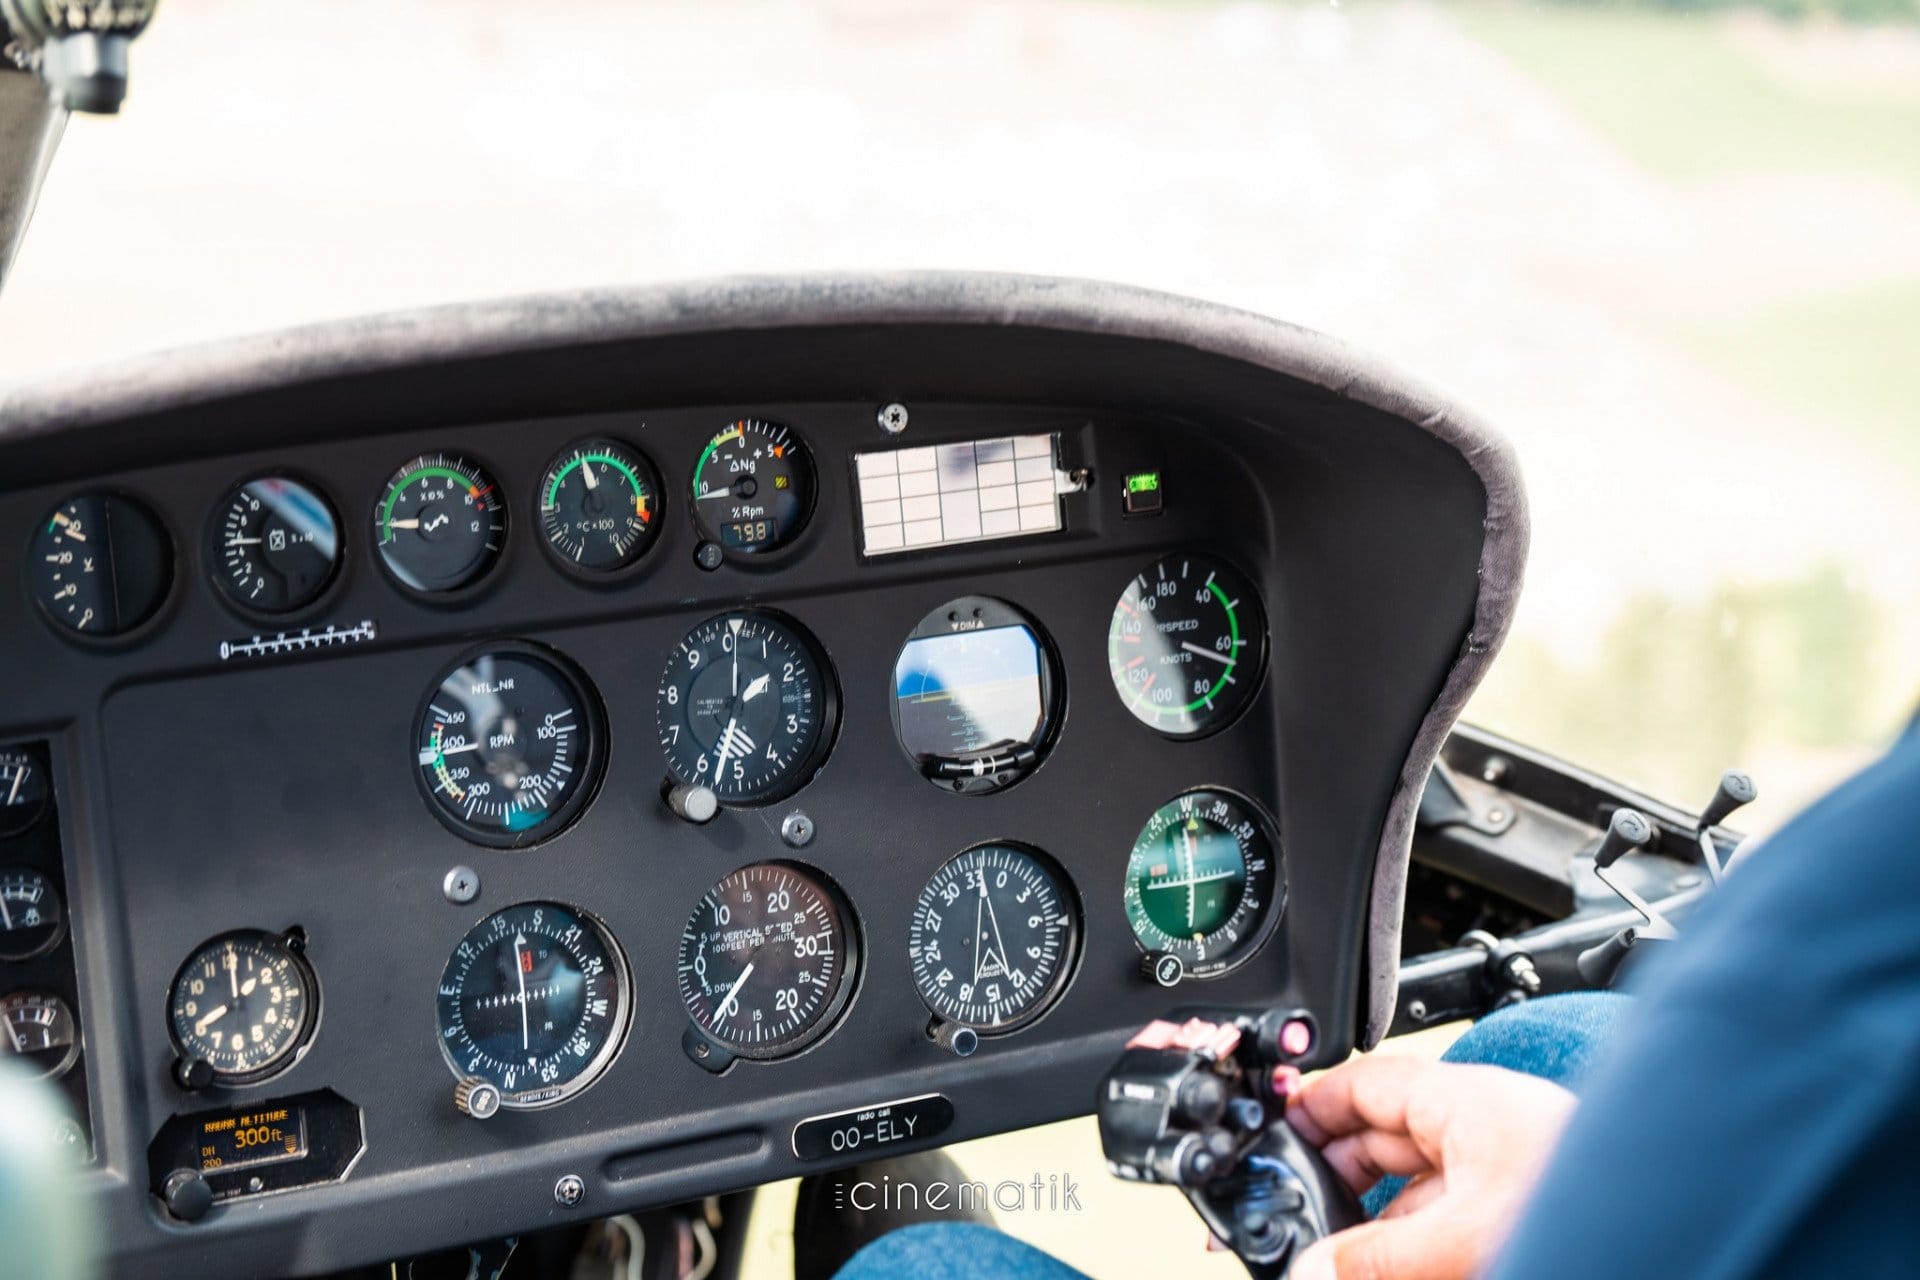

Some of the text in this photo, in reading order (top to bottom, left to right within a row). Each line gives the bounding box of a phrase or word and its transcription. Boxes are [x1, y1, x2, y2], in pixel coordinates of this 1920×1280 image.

[738, 436, 745, 448] 0
[711, 452, 718, 464] 5
[767, 444, 774, 458] 5
[601, 464, 607, 473] 6
[421, 477, 428, 488] 6
[447, 477, 454, 489] 8
[620, 476, 625, 485] 7
[700, 482, 709, 494] 10
[250, 499, 260, 511] 10
[464, 494, 473, 505] 10
[630, 495, 636, 504] 8
[742, 505, 764, 520] Rpm
[471, 520, 479, 532] 12
[563, 523, 569, 534] 2
[599, 519, 614, 530] 100
[627, 517, 633, 528] 9
[609, 533, 619, 543] 10
[59, 551, 73, 564] 20
[65, 583, 77, 596] 10
[258, 577, 264, 588] 0
[1156, 581, 1176, 596] 180
[1195, 589, 1211, 603] 40
[1137, 597, 1156, 611] 160
[85, 608, 93, 620] 0
[960, 622, 975, 631] DIM
[1122, 621, 1141, 634] 140
[1152, 619, 1199, 632] RSPEED
[722, 633, 733, 653] 0
[762, 639, 767, 659] 1
[1216, 636, 1231, 651] 60
[688, 650, 700, 670] 9
[1160, 653, 1192, 665] KNOTS
[783, 662, 794, 683] 2
[1128, 668, 1149, 682] 120
[1194, 679, 1210, 694] 80
[668, 685, 678, 705] 8
[1153, 688, 1172, 702] 100
[446, 711, 465, 723] 450
[545, 715, 553, 726] 0
[786, 713, 798, 734] 3
[537, 726, 556, 740] 100
[669, 725, 680, 745] 7
[442, 735, 465, 749] 400
[490, 736, 515, 748] RPM
[766, 742, 778, 761] 4
[697, 753, 709, 773] 6
[733, 760, 744, 779] 5
[450, 767, 470, 779] 350
[468, 782, 490, 797] 300
[519, 775, 541, 790] 200
[1180, 796, 1193, 813] W
[1212, 801, 1228, 816] 30
[1239, 821, 1254, 839] 33
[1251, 859, 1266, 871] N
[965, 869, 983, 890] 33
[996, 871, 1007, 888] 0
[743, 891, 752, 903] 15
[767, 890, 789, 913] 20
[940, 883, 960, 907] 30
[1016, 887, 1031, 903] 3
[491, 915, 506, 932] 15
[533, 909, 544, 925] S
[714, 905, 730, 927] 10
[794, 912, 806, 924] 25
[925, 909, 942, 933] 27
[1028, 915, 1043, 928] 6
[566, 923, 583, 944] 21
[710, 932, 721, 941] UP
[723, 927, 762, 942] VERTICAL
[750, 936, 764, 947] PER
[794, 935, 818, 959] 30
[457, 941, 474, 959] 12
[924, 939, 941, 964] 24
[1026, 946, 1041, 959] 9
[1197, 946, 1205, 960] E
[205, 962, 216, 978] 11
[588, 956, 604, 975] 24
[694, 955, 706, 976] 0
[260, 967, 273, 985] 2
[798, 971, 811, 984] 25
[935, 968, 954, 988] 21
[1008, 968, 1027, 989] 12
[190, 979, 204, 995] 10
[440, 984, 455, 996] E
[959, 983, 975, 1002] 18
[986, 983, 1001, 1002] 15
[270, 986, 282, 1004] 3
[775, 988, 798, 1011] 20
[186, 1001, 197, 1017] 9
[264, 1007, 278, 1024] 4
[591, 1000, 608, 1017] W
[753, 1009, 762, 1021] 15
[211, 1031, 223, 1049] 7
[252, 1024, 264, 1042] 5
[444, 1027, 458, 1038] 6
[232, 1034, 244, 1051] 6
[573, 1036, 591, 1057] 30
[504, 1071, 516, 1089] N
[541, 1064, 559, 1083] 33
[241, 1110, 288, 1126] ALTITUDE
[857, 1108, 891, 1121] radio call
[235, 1126, 282, 1148] 300 ft
[202, 1146, 215, 1156] DH
[203, 1158, 222, 1169] 200
